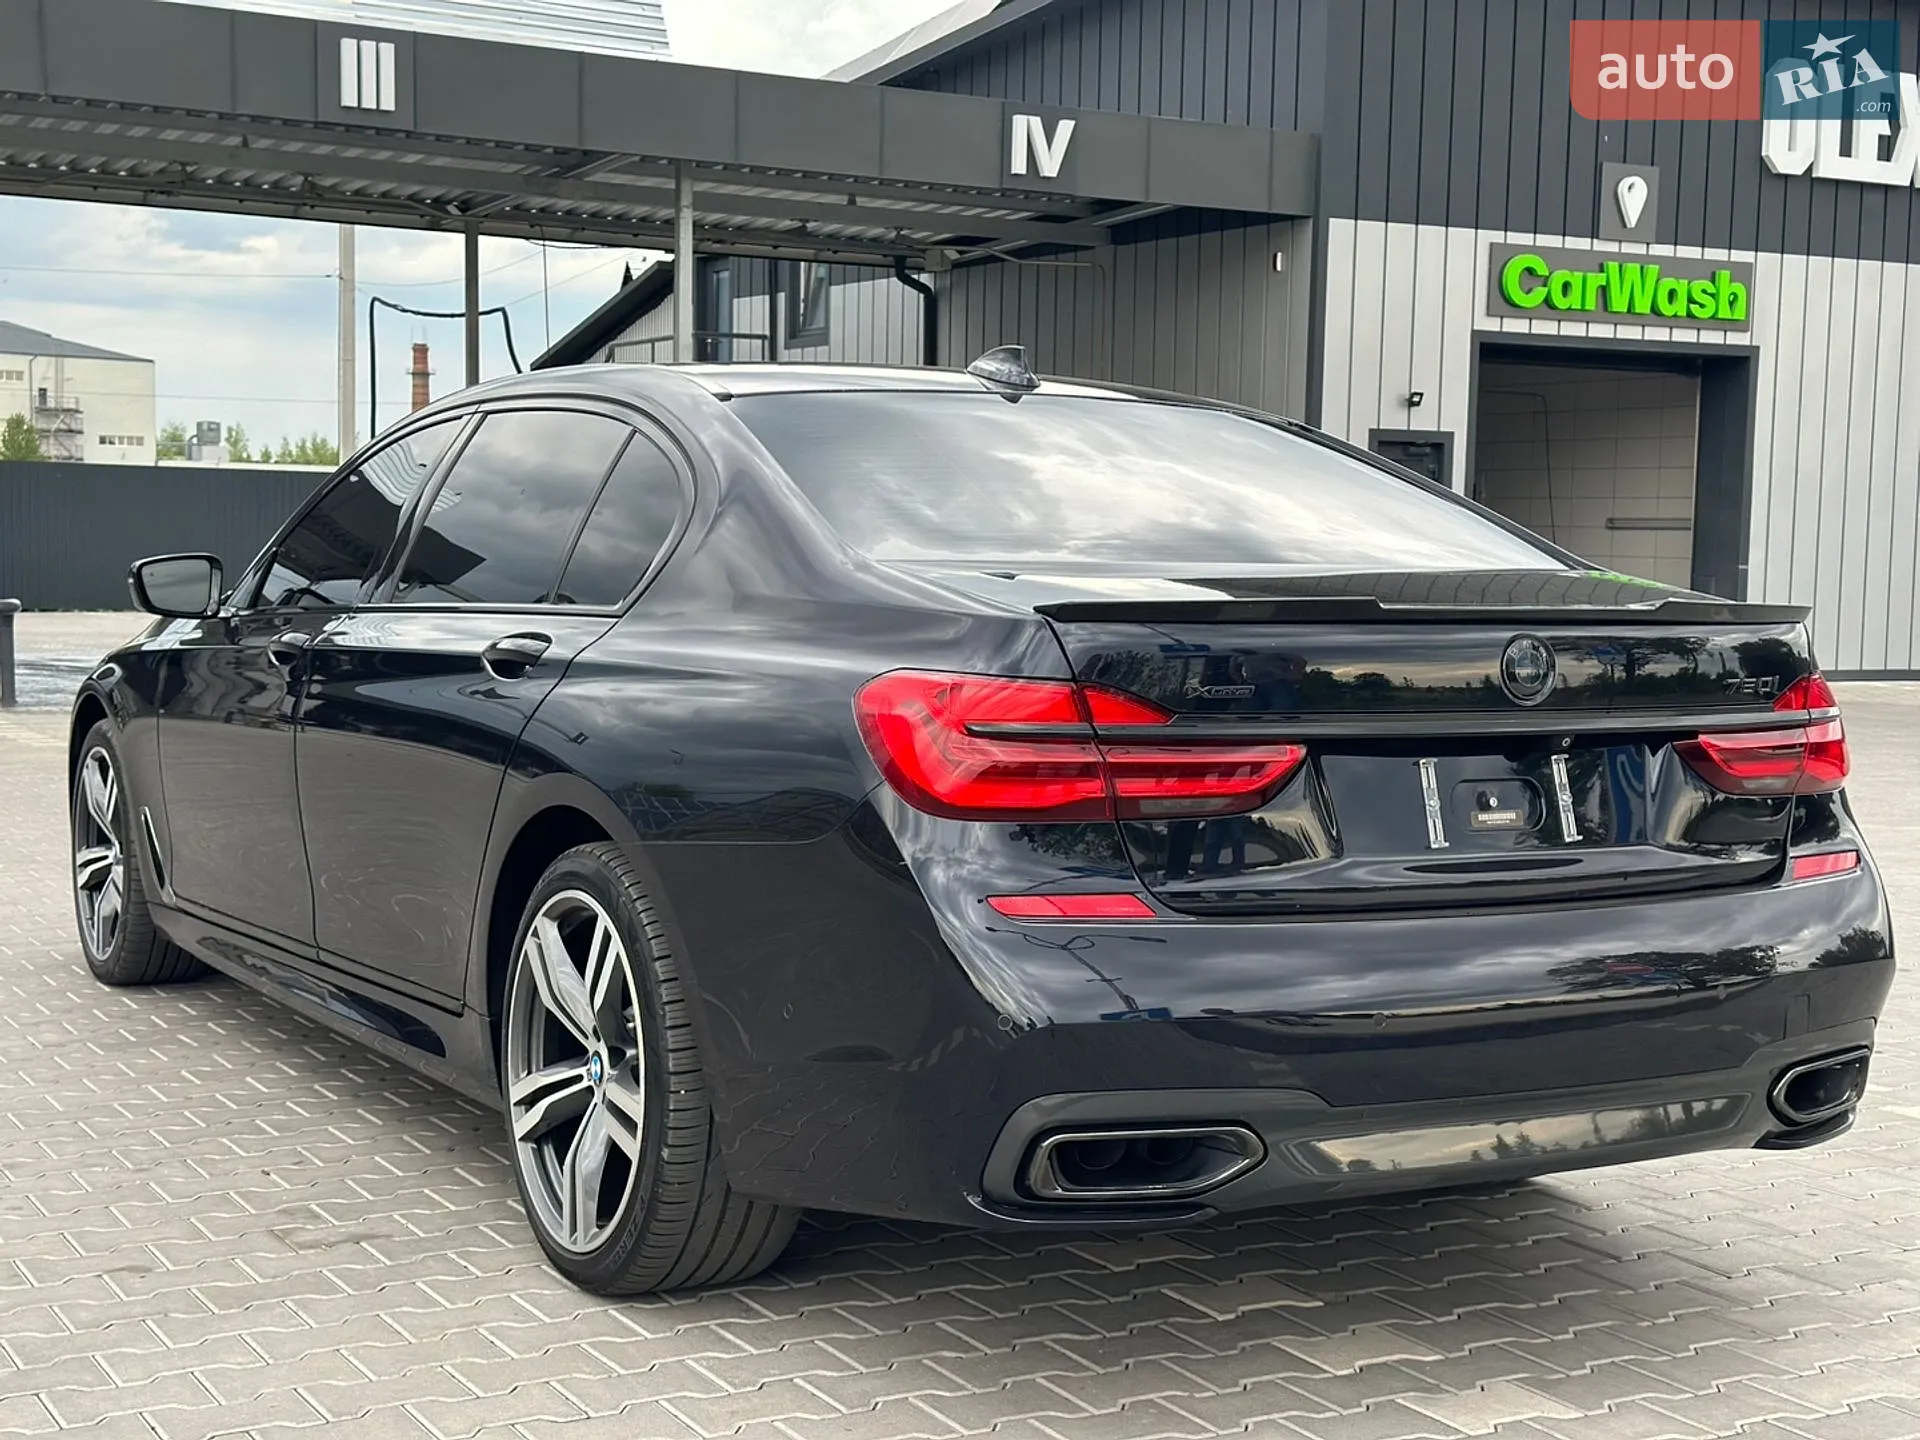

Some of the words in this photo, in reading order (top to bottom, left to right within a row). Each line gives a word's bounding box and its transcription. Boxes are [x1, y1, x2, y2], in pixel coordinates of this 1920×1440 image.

[340, 37, 395, 111] III
[1011, 114, 1076, 177] IV
[1501, 253, 1747, 321] CarWash
